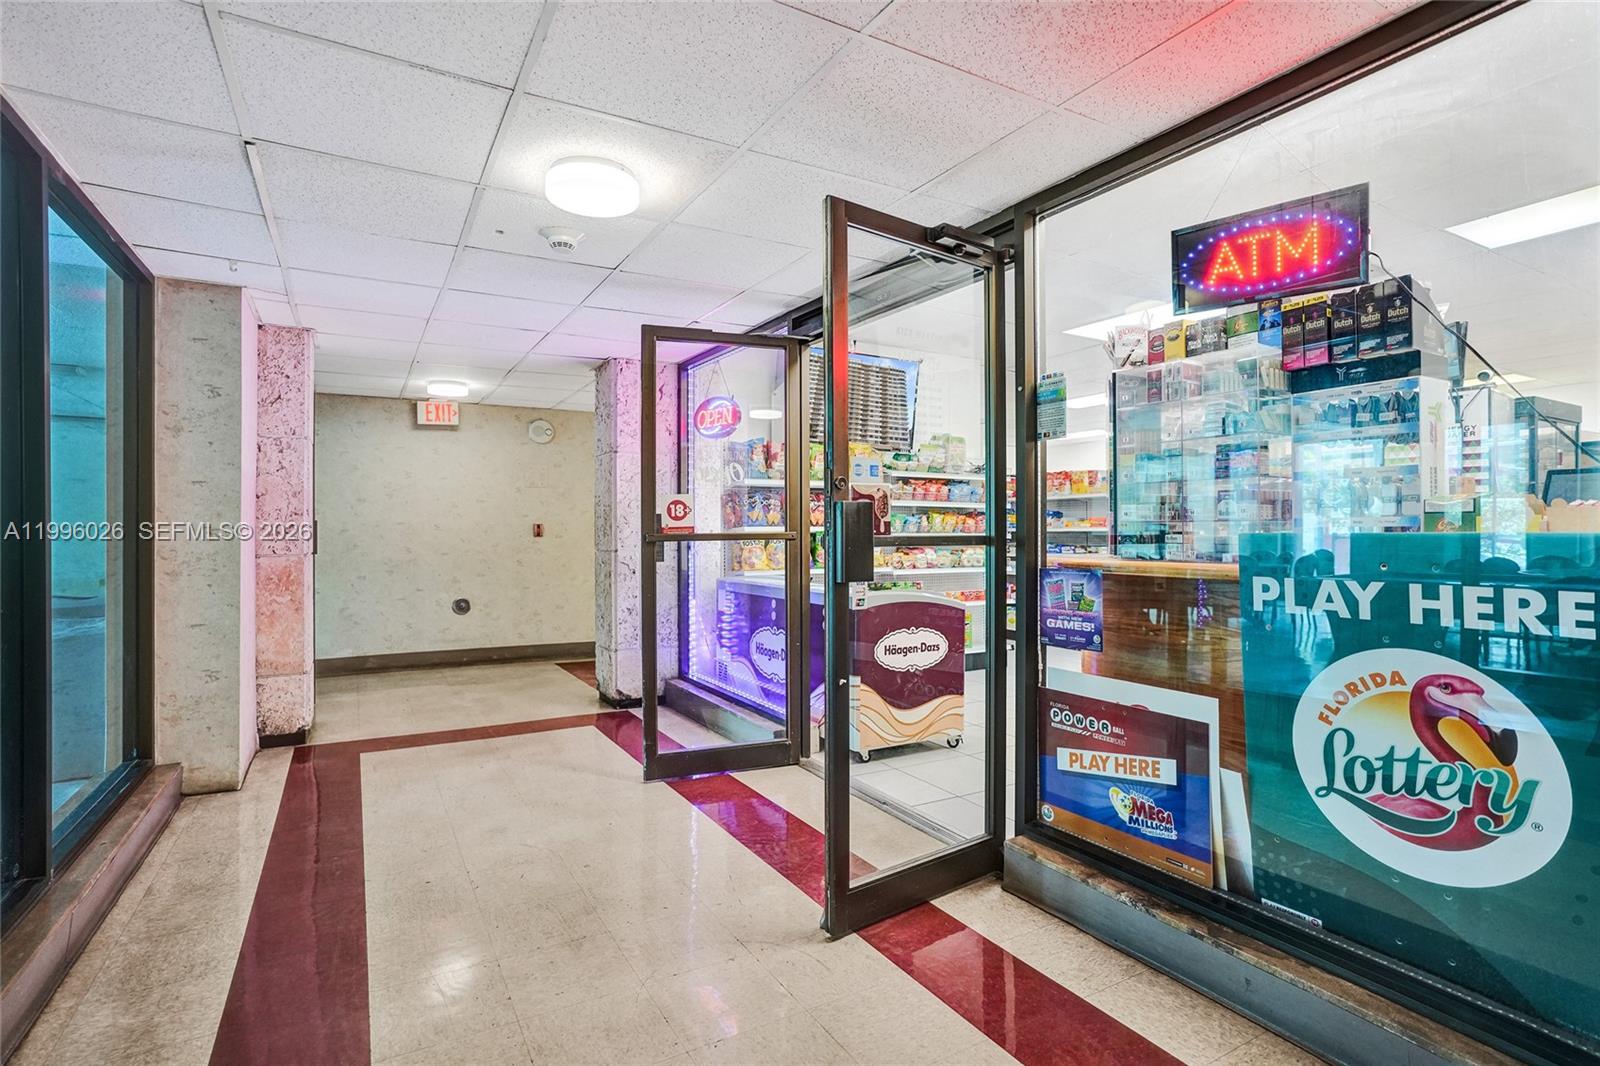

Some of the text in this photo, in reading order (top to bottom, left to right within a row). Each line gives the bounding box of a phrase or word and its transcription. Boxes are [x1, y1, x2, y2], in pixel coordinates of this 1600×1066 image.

[1208, 220, 1319, 285] ATM
[1360, 313, 1381, 323] Dutch
[1387, 307, 1409, 317] Dutch
[1305, 319, 1325, 330] Dutch
[1334, 318, 1353, 329] Dutch
[425, 402, 453, 422] EXIT
[697, 406, 734, 428] OPEN
[670, 504, 690, 517] 18+
[1252, 576, 1597, 641] PLAY HERE
[1046, 618, 1095, 632] GAMES!
[884, 642, 940, 657] Häagen-Dazs
[1317, 670, 1408, 726] FLORIDA
[1069, 752, 1161, 779] PLAY HERE
[1315, 727, 1541, 835] Lottery
[1129, 796, 1173, 826] MEGA
[1128, 815, 1174, 833] MILLIONS
